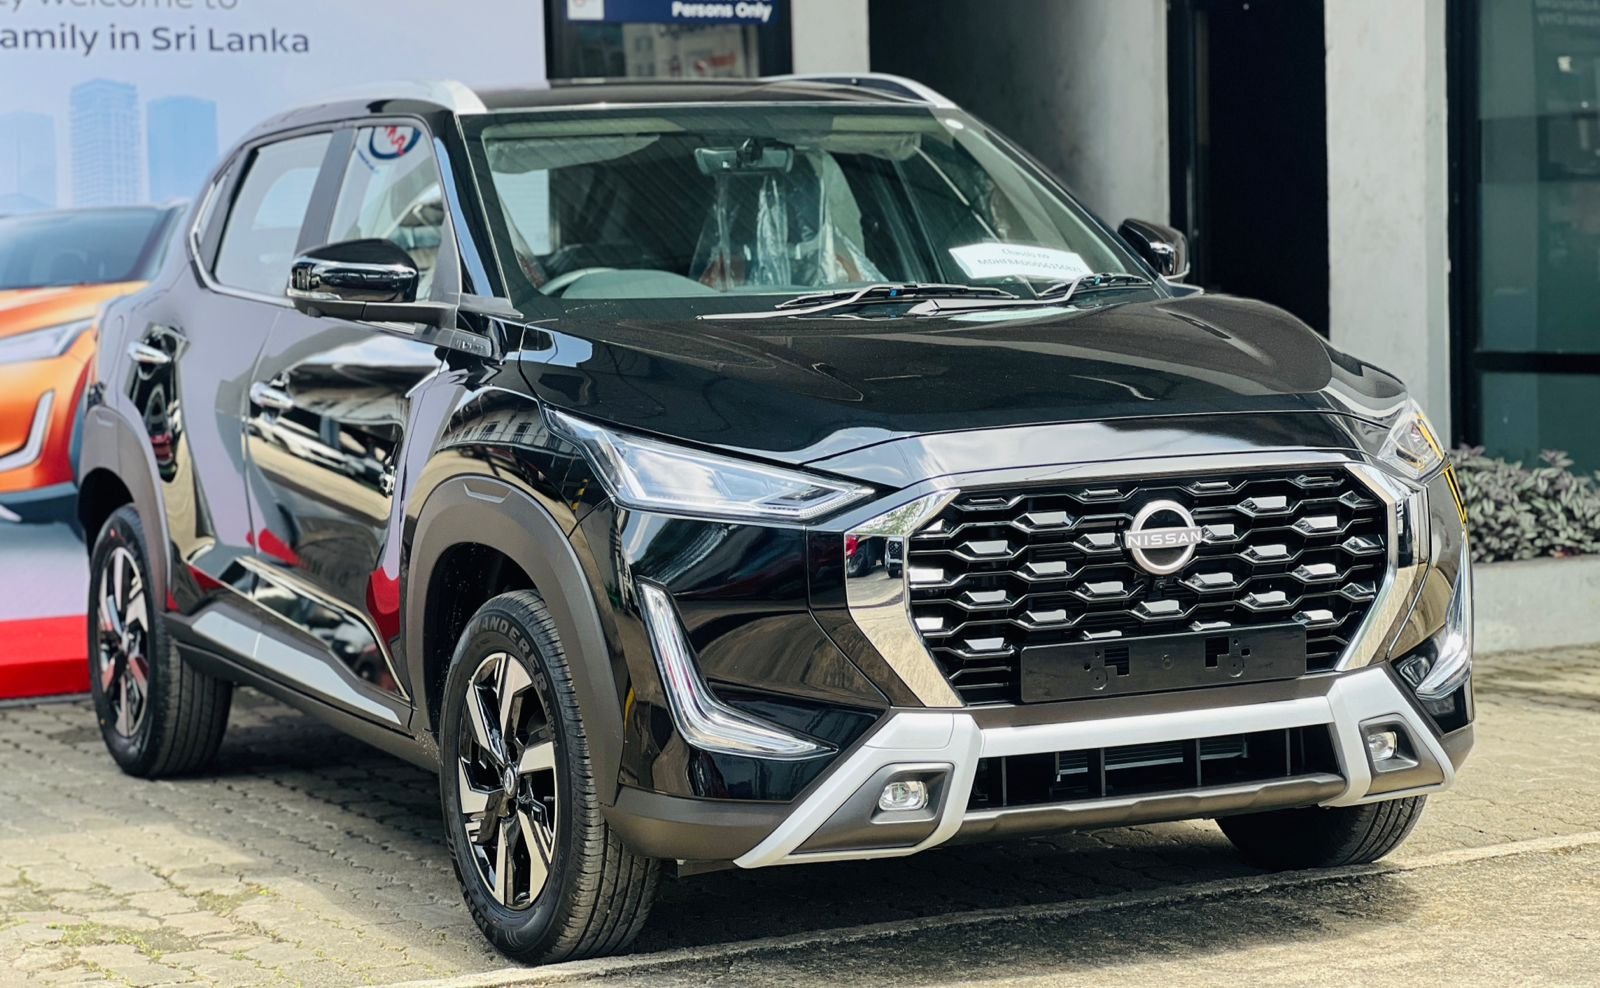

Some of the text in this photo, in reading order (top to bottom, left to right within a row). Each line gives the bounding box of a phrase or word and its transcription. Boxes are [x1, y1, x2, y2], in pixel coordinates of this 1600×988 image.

[671, 1, 773, 22] Persons Only
[109, 23, 141, 50] in
[151, 24, 196, 51] Sri
[207, 26, 310, 53] Lanka
[1128, 530, 1201, 546] NISSAN
